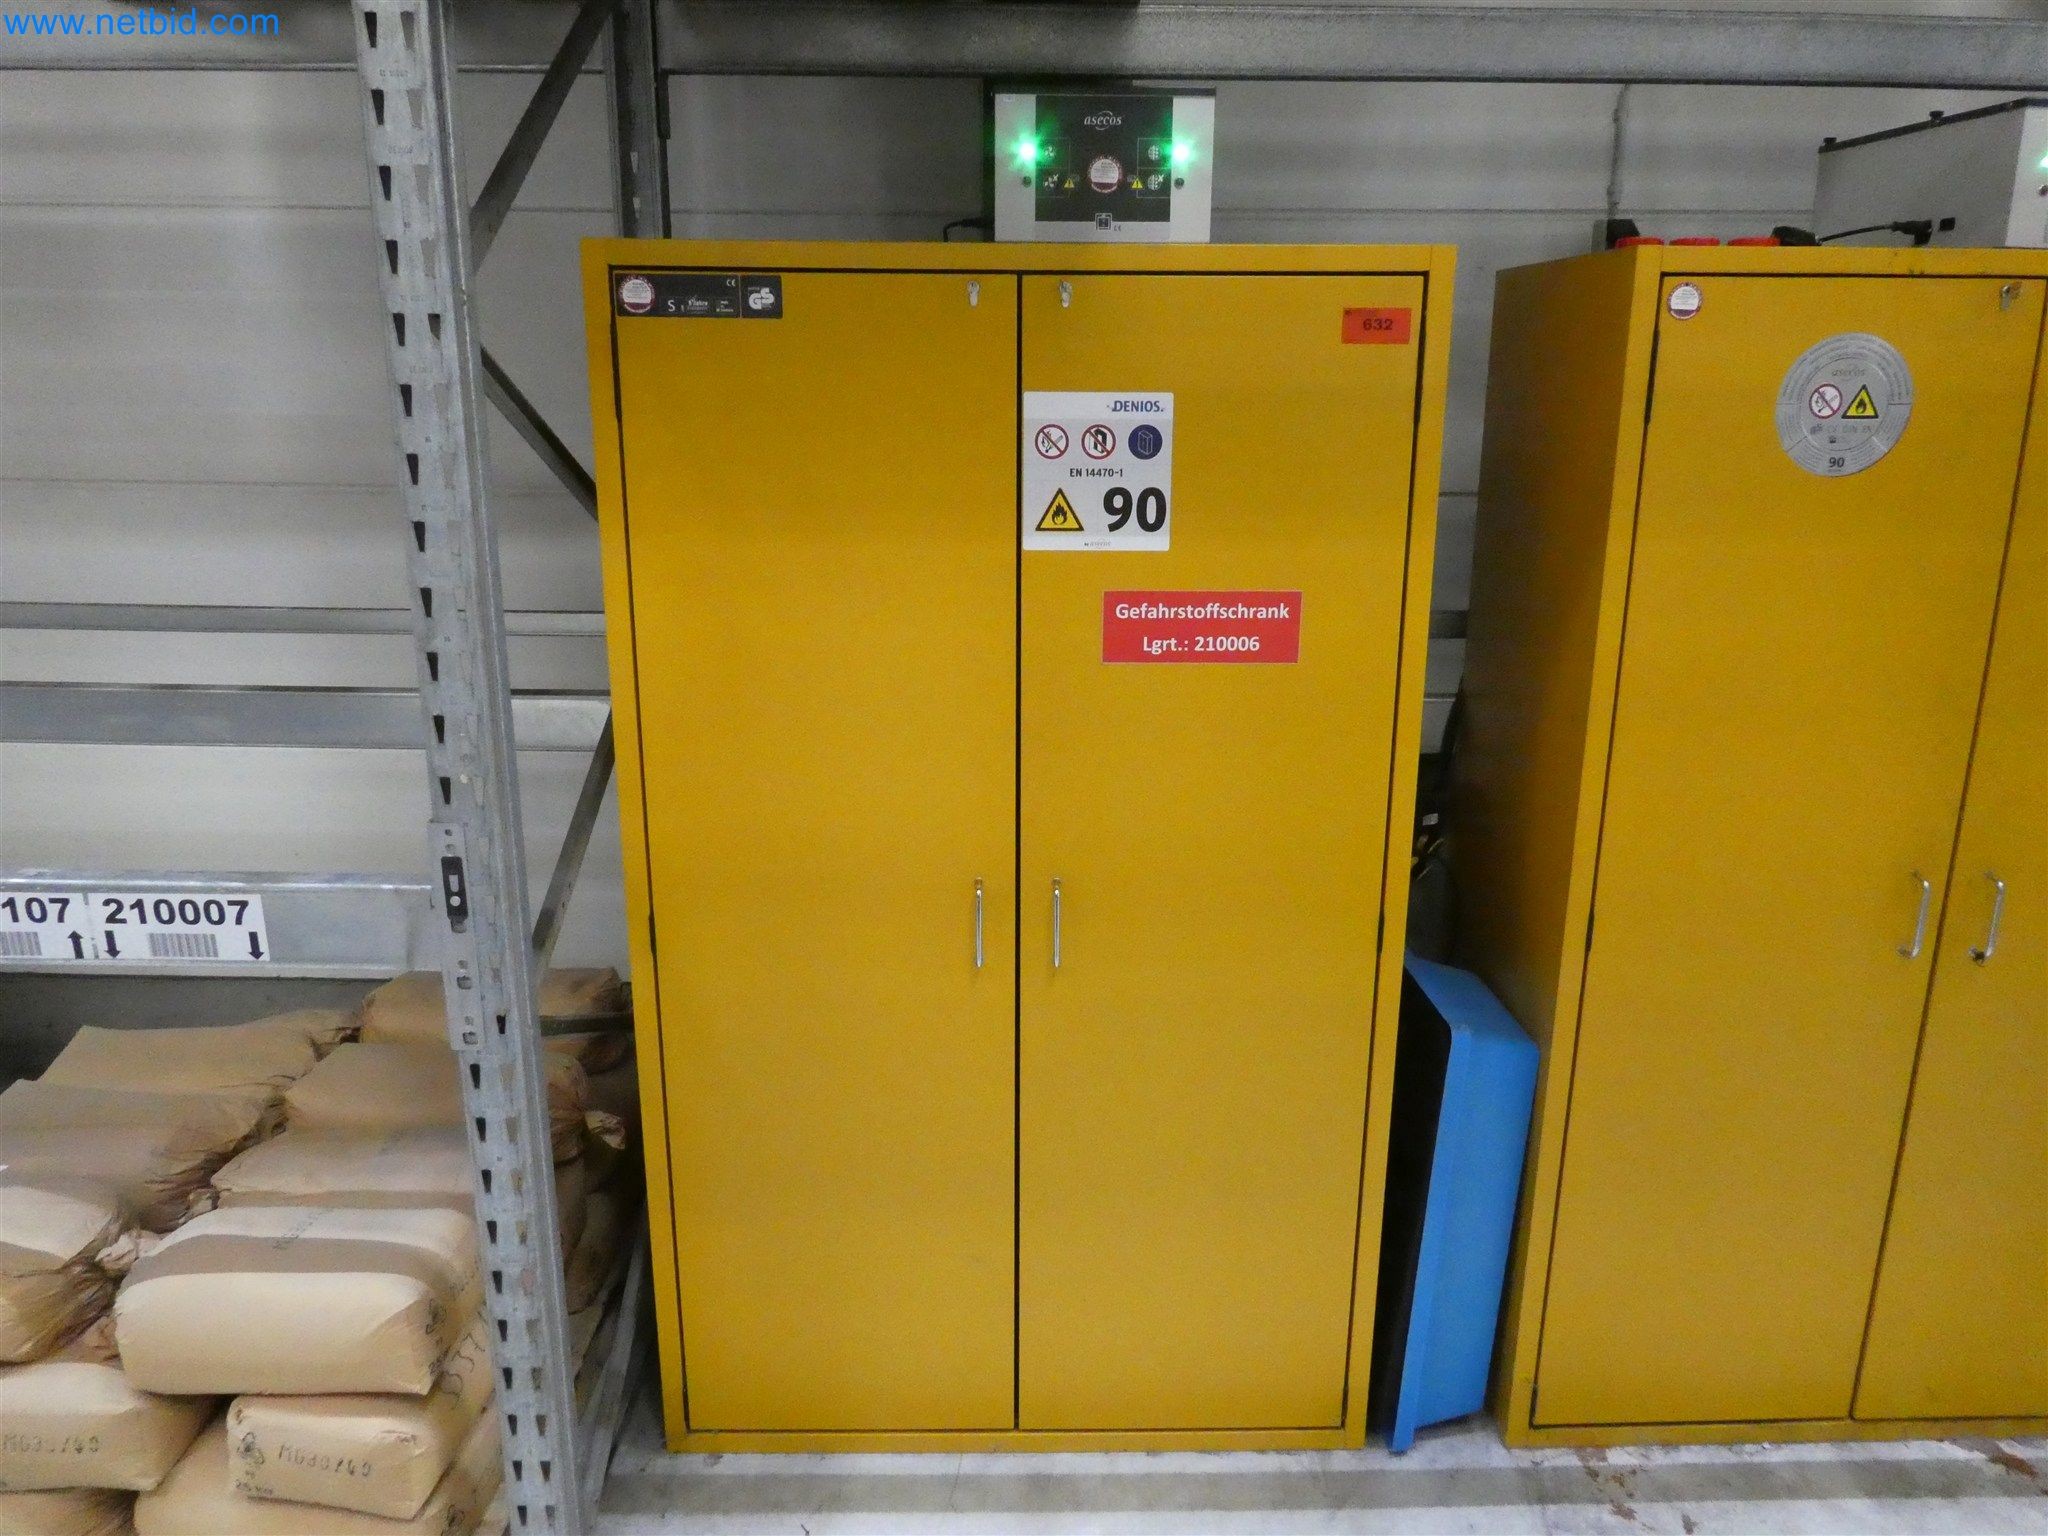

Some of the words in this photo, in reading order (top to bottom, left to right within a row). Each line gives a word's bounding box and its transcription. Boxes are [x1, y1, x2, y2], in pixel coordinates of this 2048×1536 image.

[1083, 112, 1123, 127] asecos
[1362, 318, 1394, 331] 632
[1828, 457, 1845, 468] 90
[1069, 468, 1083, 478] EN
[1085, 468, 1124, 478] 14470-1
[1103, 486, 1167, 533] 90
[1115, 603, 1290, 619] Gefahrstoffschrank
[1143, 636, 1189, 655] Lgrt.:
[1194, 636, 1260, 651] 210006
[102, 898, 250, 926] 210007
